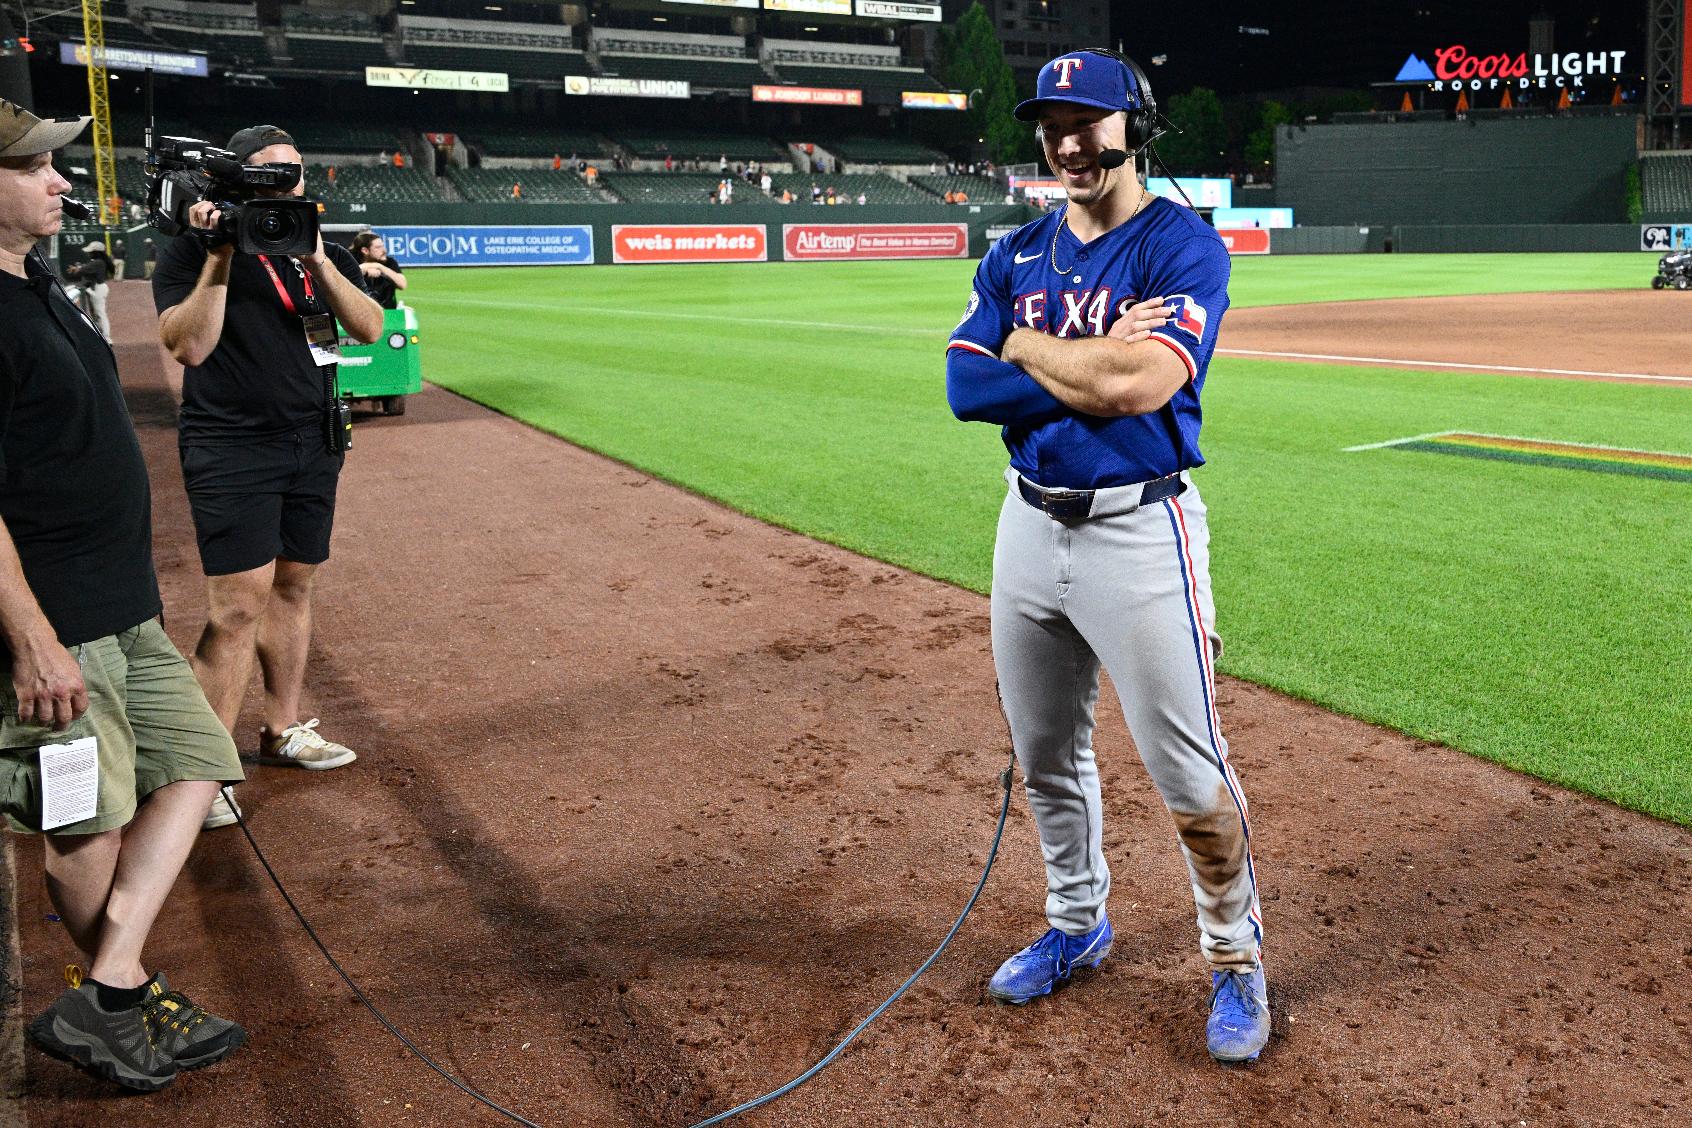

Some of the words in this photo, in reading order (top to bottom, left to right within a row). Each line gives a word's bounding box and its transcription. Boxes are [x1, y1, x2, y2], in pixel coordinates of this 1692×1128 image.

[1435, 45, 1529, 79] Coors
[1535, 51, 1626, 77] LIGHT
[1053, 58, 1083, 89] T
[639, 79, 687, 96] UNION
[1434, 79, 1499, 91] ROOF
[1520, 76, 1583, 88] DECK
[387, 234, 479, 258] ECOM
[484, 236, 505, 245] LAKE
[506, 236, 525, 245] ERIE
[525, 236, 560, 245] COLLEGE
[562, 236, 574, 244] OF
[484, 245, 540, 254] OSTEOPATHIC
[541, 245, 579, 253] MEDICINE
[625, 234, 673, 250] weis
[675, 233, 756, 250] markets
[796, 231, 855, 251] Airtemp
[1014, 286, 1144, 338] EXA
